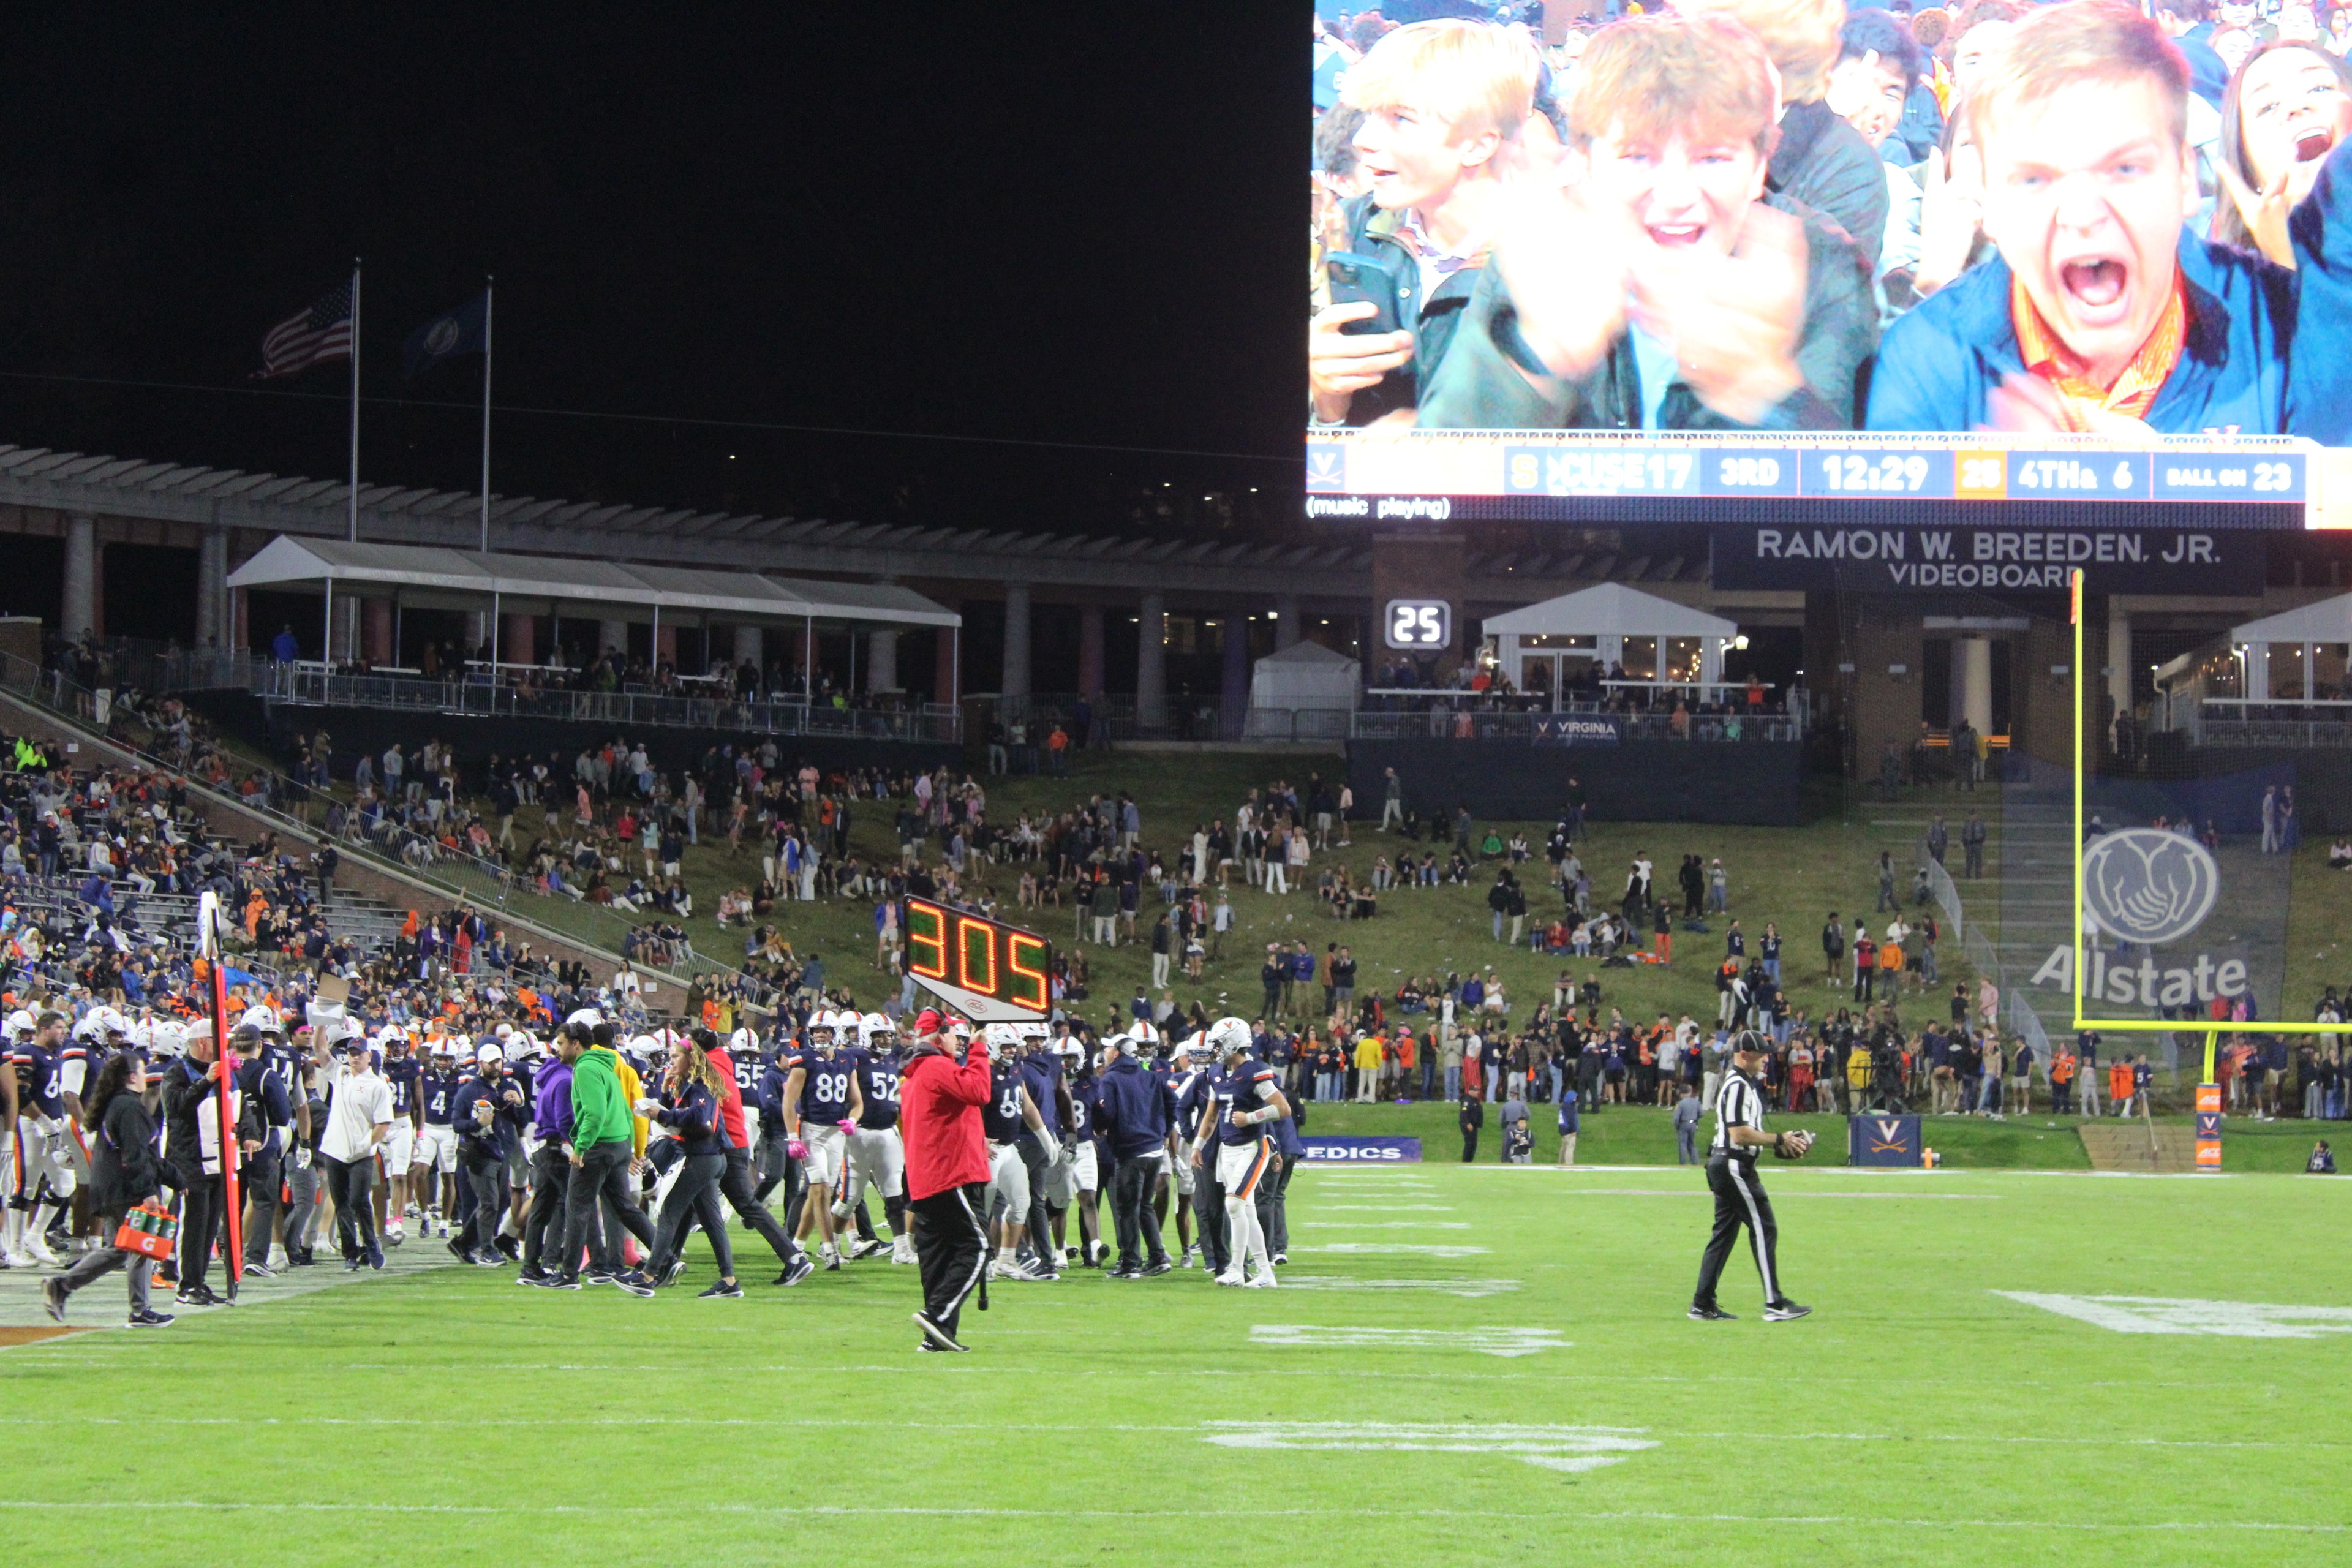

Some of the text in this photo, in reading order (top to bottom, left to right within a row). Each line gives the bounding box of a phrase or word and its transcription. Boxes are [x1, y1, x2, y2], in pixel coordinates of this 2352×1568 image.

[1647, 454, 1692, 489] 17
[1720, 458, 1779, 486] 3RD
[1822, 455, 1928, 491] 12:29
[2113, 461, 2133, 489] 6
[2166, 462, 2291, 491] BALL ON 23
[1306, 496, 1450, 520] (music playing)
[1757, 529, 1905, 560] RAMON
[1920, 531, 1956, 560] W.
[2161, 534, 2221, 564] JR.
[1888, 563, 2086, 588] VIDEOBOARD
[1395, 606, 1440, 641] 25
[1558, 722, 1616, 734] VIRGINIA
[2029, 943, 2247, 1007] Allstate
[735, 1063, 767, 1090] 55
[816, 1073, 848, 1103] 88
[871, 1071, 899, 1101] 52
[431, 1090, 447, 1115] 4
[1219, 1093, 1234, 1123] 7
[1303, 1147, 1403, 1159] EDICS
[141, 1237, 156, 1251] G
